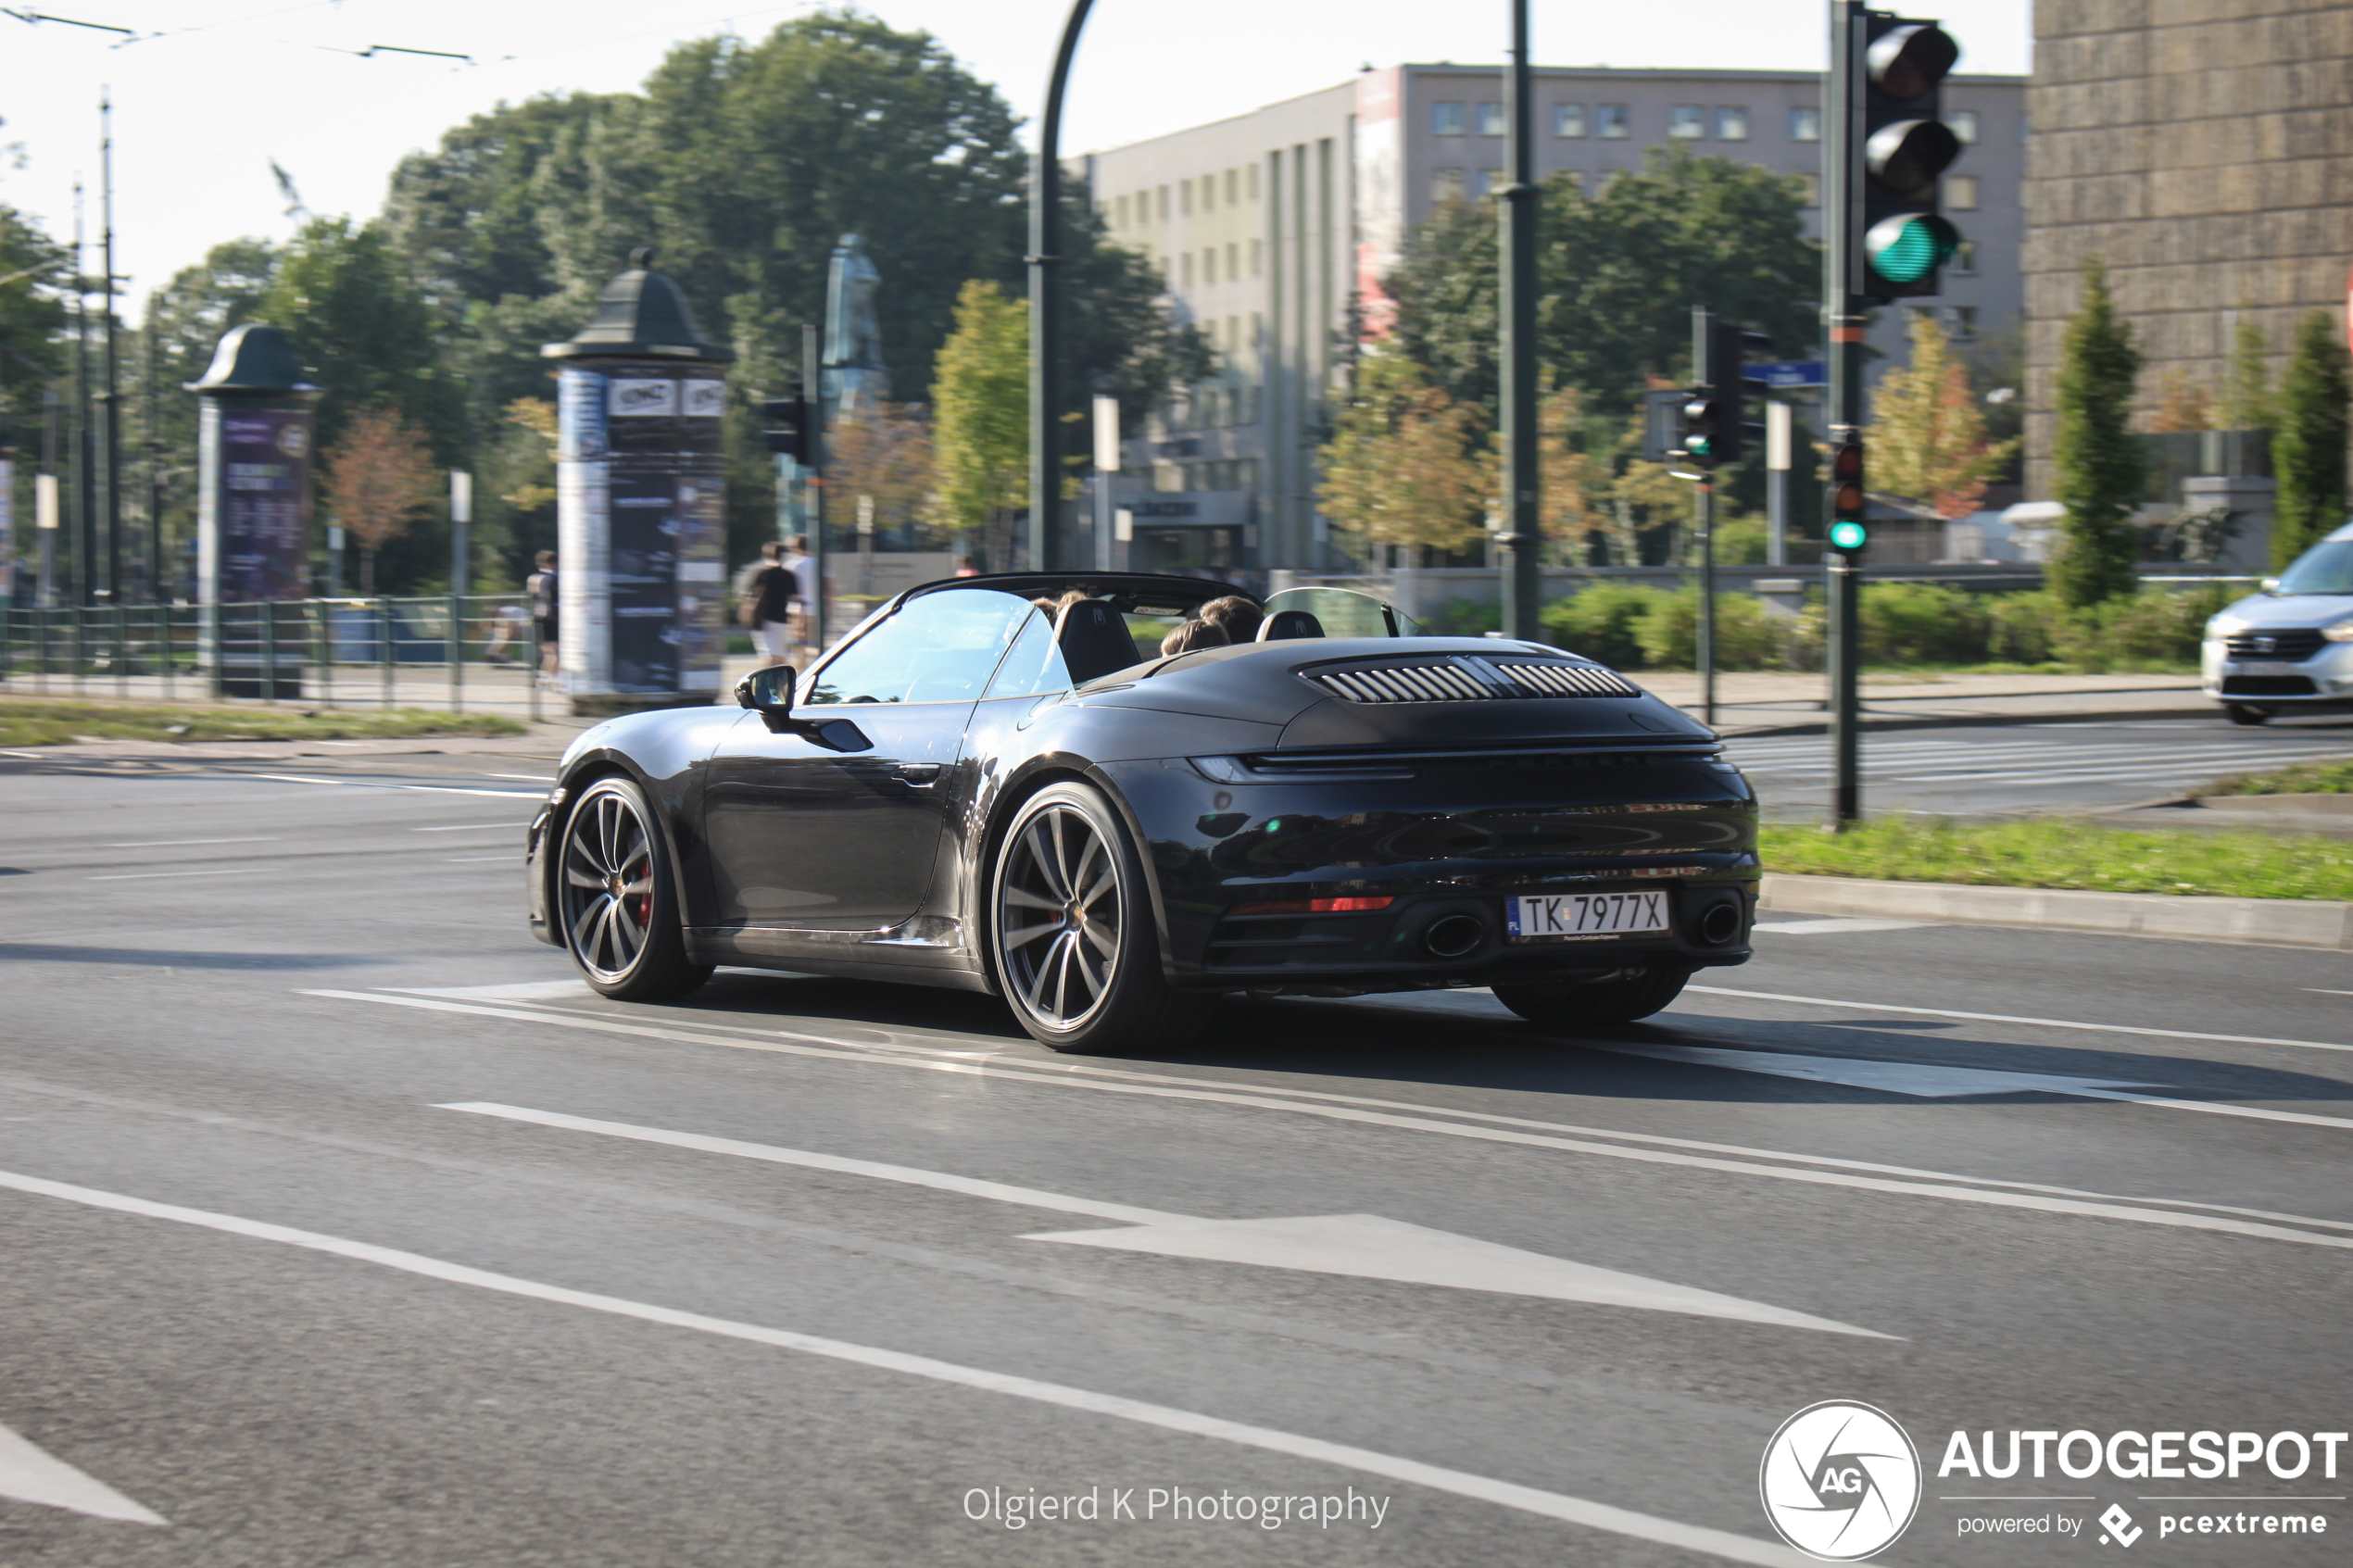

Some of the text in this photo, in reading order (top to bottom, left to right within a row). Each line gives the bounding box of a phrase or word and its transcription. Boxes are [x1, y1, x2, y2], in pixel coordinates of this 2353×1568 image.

[1526, 893, 1661, 932] TK 7977X
[1508, 922, 1520, 931] PL
